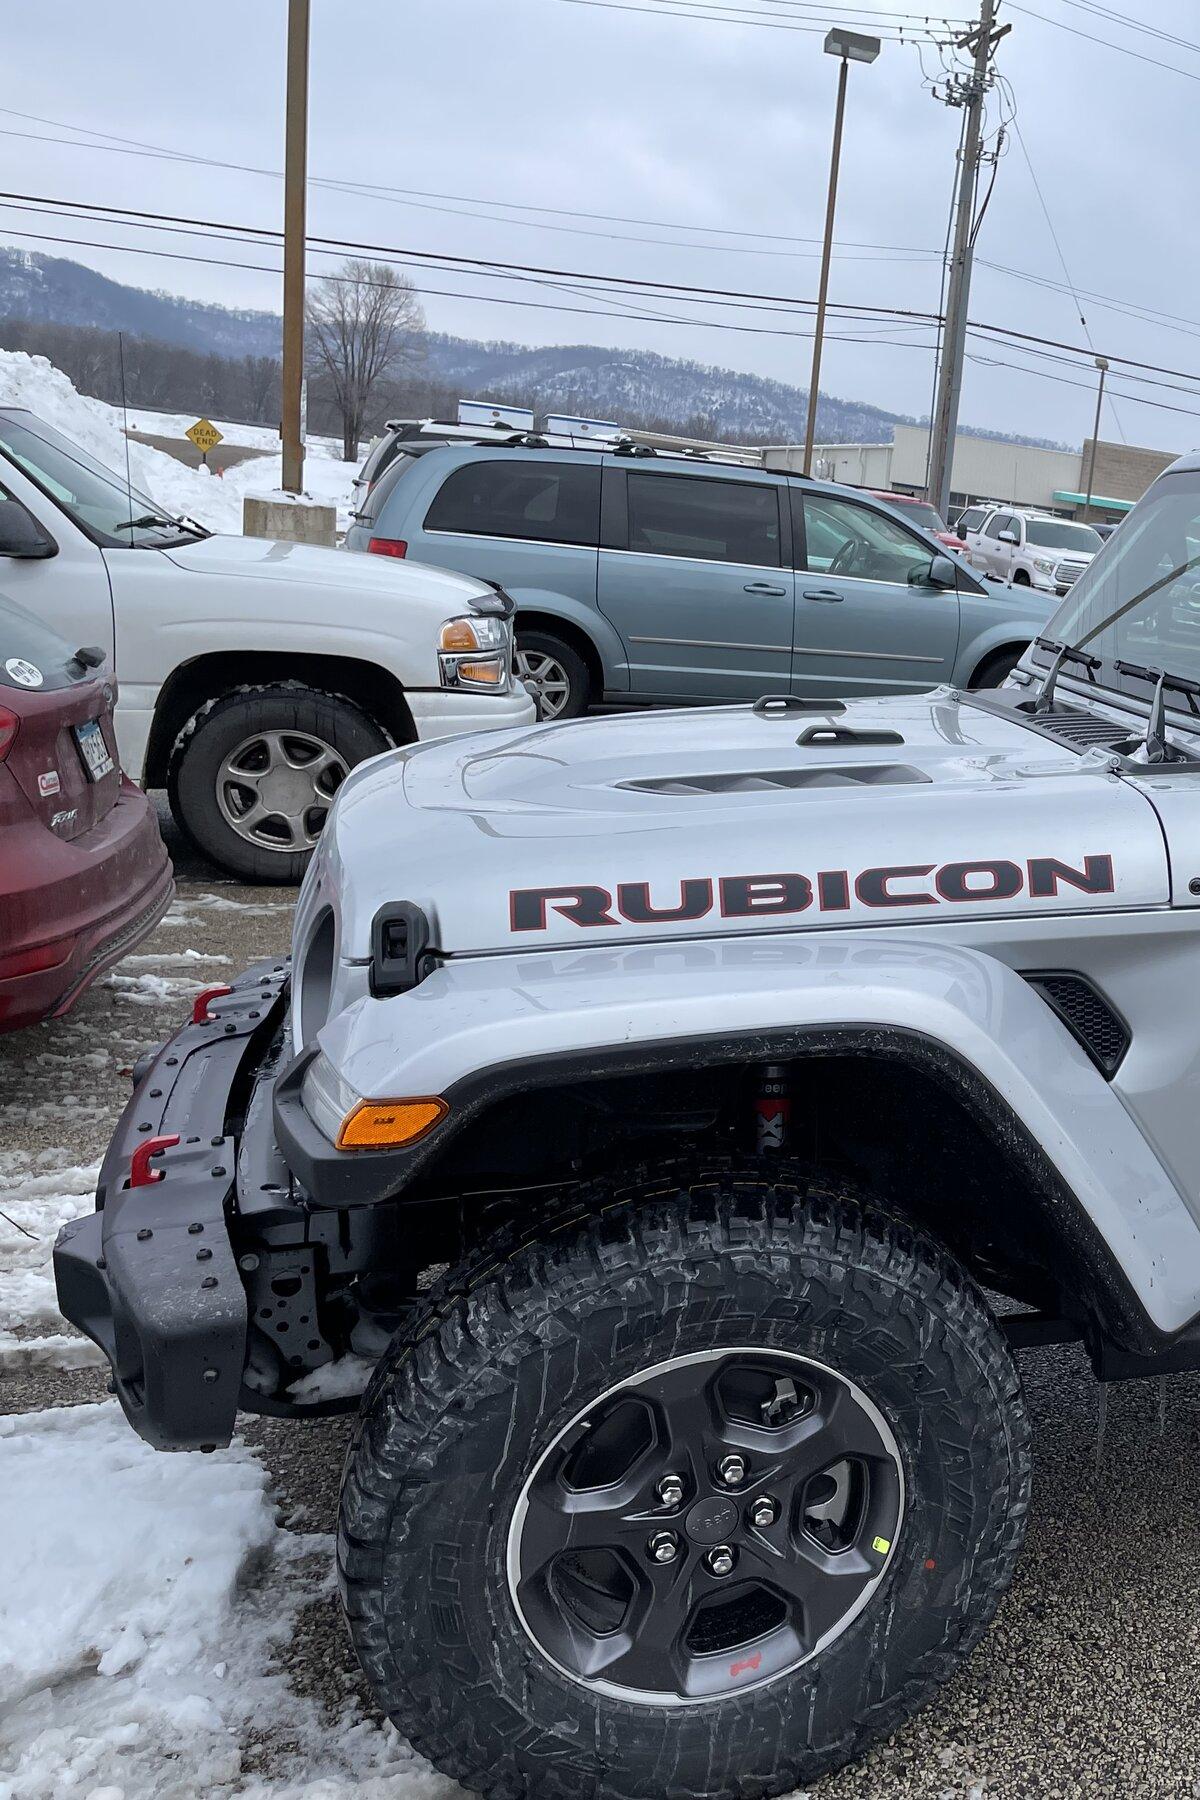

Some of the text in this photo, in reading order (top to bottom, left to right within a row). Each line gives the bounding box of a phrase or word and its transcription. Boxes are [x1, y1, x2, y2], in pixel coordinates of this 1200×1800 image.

[193, 428, 217, 437] DEAD
[196, 437, 214, 446] END
[508, 853, 1115, 932] RUBICON
